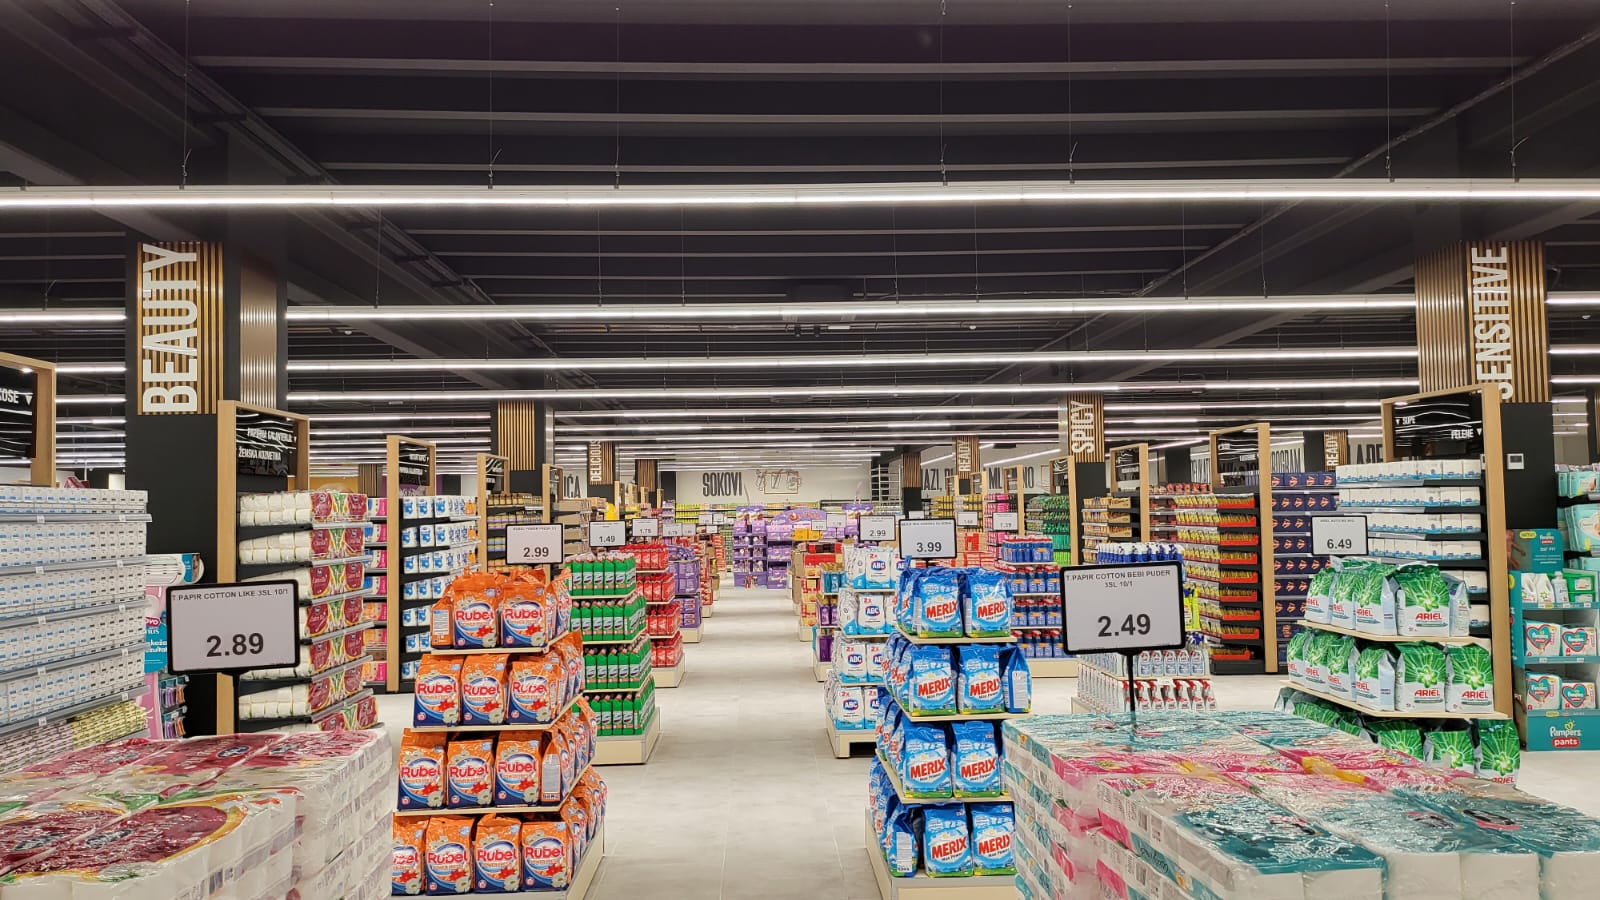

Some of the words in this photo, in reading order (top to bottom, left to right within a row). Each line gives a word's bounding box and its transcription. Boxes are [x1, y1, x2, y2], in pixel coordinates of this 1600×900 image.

[142, 243, 198, 412] BEAUTY
[0, 388, 19, 404] OSE
[1070, 400, 1095, 453] SPICY
[958, 440, 971, 472] READY
[702, 471, 743, 497] SOKOVI
[599, 535, 616, 543] 1.49
[869, 529, 886, 537] 2.99
[916, 541, 942, 553] 3.99
[1327, 538, 1352, 549] 6.49
[523, 546, 549, 558] 2.99
[1095, 572, 1126, 580] COTTON
[1146, 569, 1171, 577] PUDER
[178, 593, 202, 601] PAPIR
[203, 591, 237, 600] COTTON
[238, 590, 256, 598] LIKE
[455, 610, 494, 621] Rubel
[504, 608, 543, 619] Rubel
[1415, 612, 1443, 620] ARIEL
[1097, 613, 1151, 638] 2.49
[206, 632, 264, 657] 2.89
[417, 681, 457, 695] Rubel
[463, 682, 501, 696] Rubel
[917, 676, 952, 696] MERIX
[1414, 689, 1441, 697] ARIEL
[1461, 691, 1489, 699] ARIEL
[1549, 726, 1582, 738] Pampers
[1553, 738, 1578, 747] pants
[401, 765, 440, 778] Rubel
[449, 764, 489, 778] Rubel
[497, 760, 537, 773] Rubel
[910, 757, 947, 779] MERIX
[960, 757, 996, 778] MERIX
[525, 845, 565, 859] Rubel
[931, 836, 967, 859] MERIX
[428, 850, 468, 864] Rubel
[477, 848, 517, 861] Rubel
